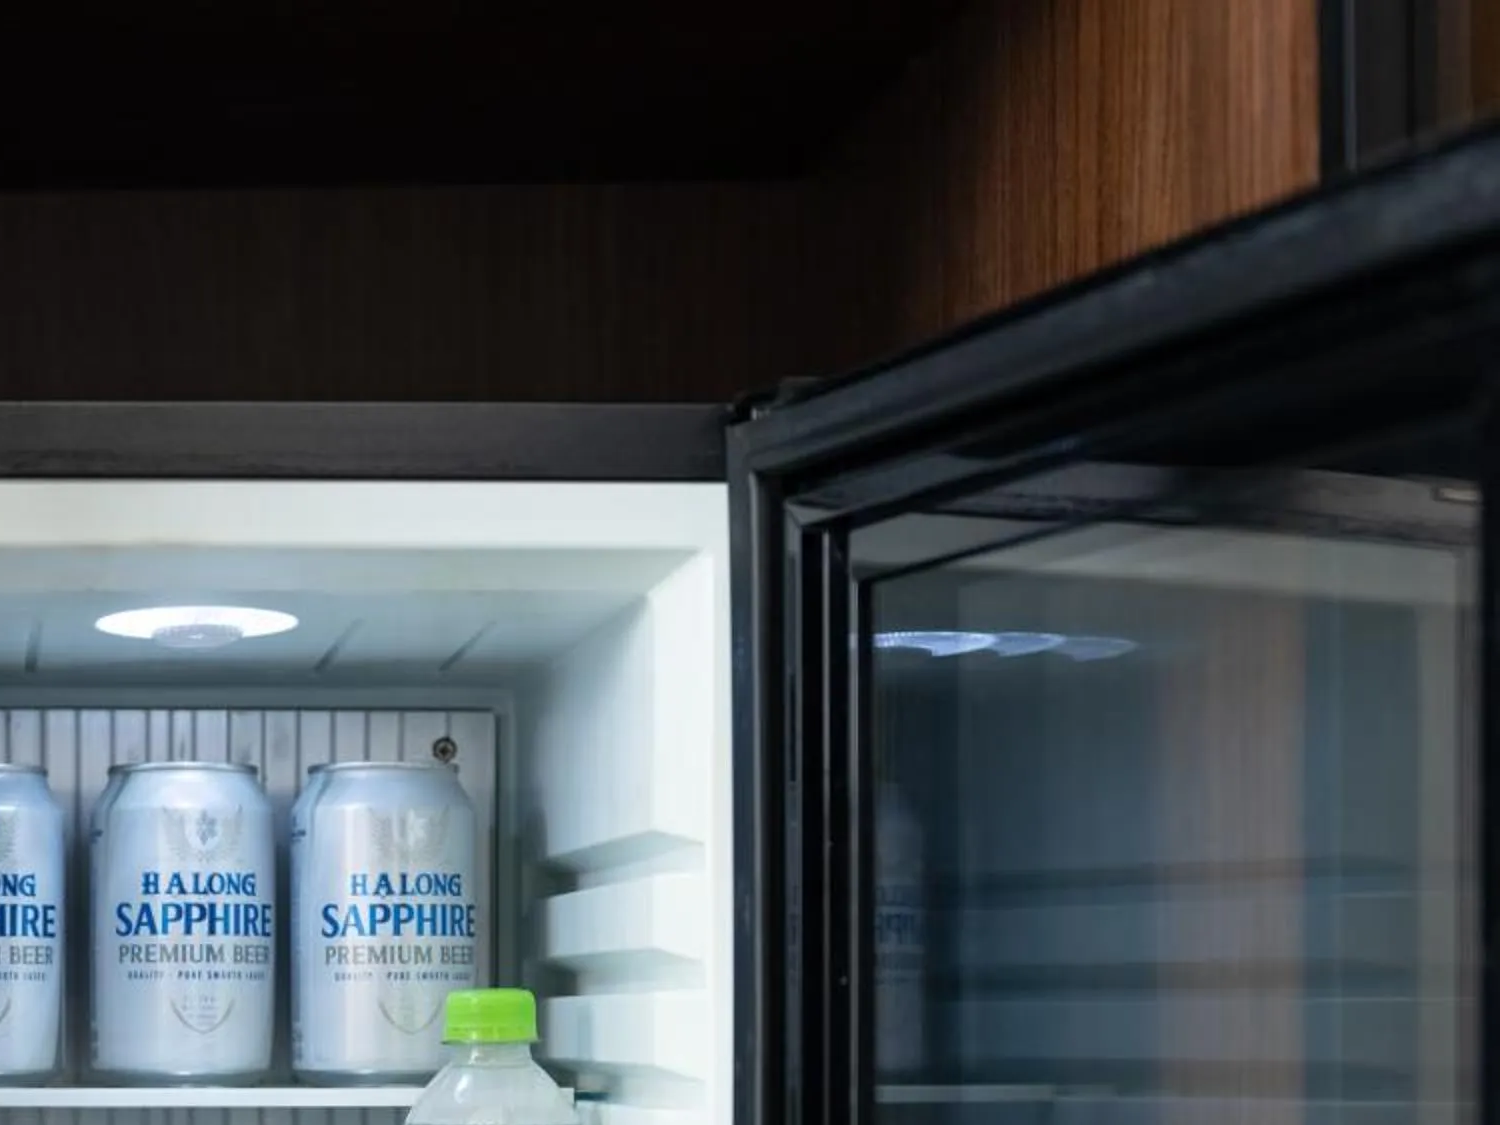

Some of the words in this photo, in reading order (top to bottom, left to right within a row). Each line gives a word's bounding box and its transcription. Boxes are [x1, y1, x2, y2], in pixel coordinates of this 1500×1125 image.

[115, 902, 272, 937] SAPPHIRE
[321, 902, 476, 938] SAPPHIRE
[8, 944, 54, 966] BEER
[118, 943, 225, 964] PREMIUM
[232, 943, 271, 965] BEER
[325, 944, 432, 965] PREMIUM
